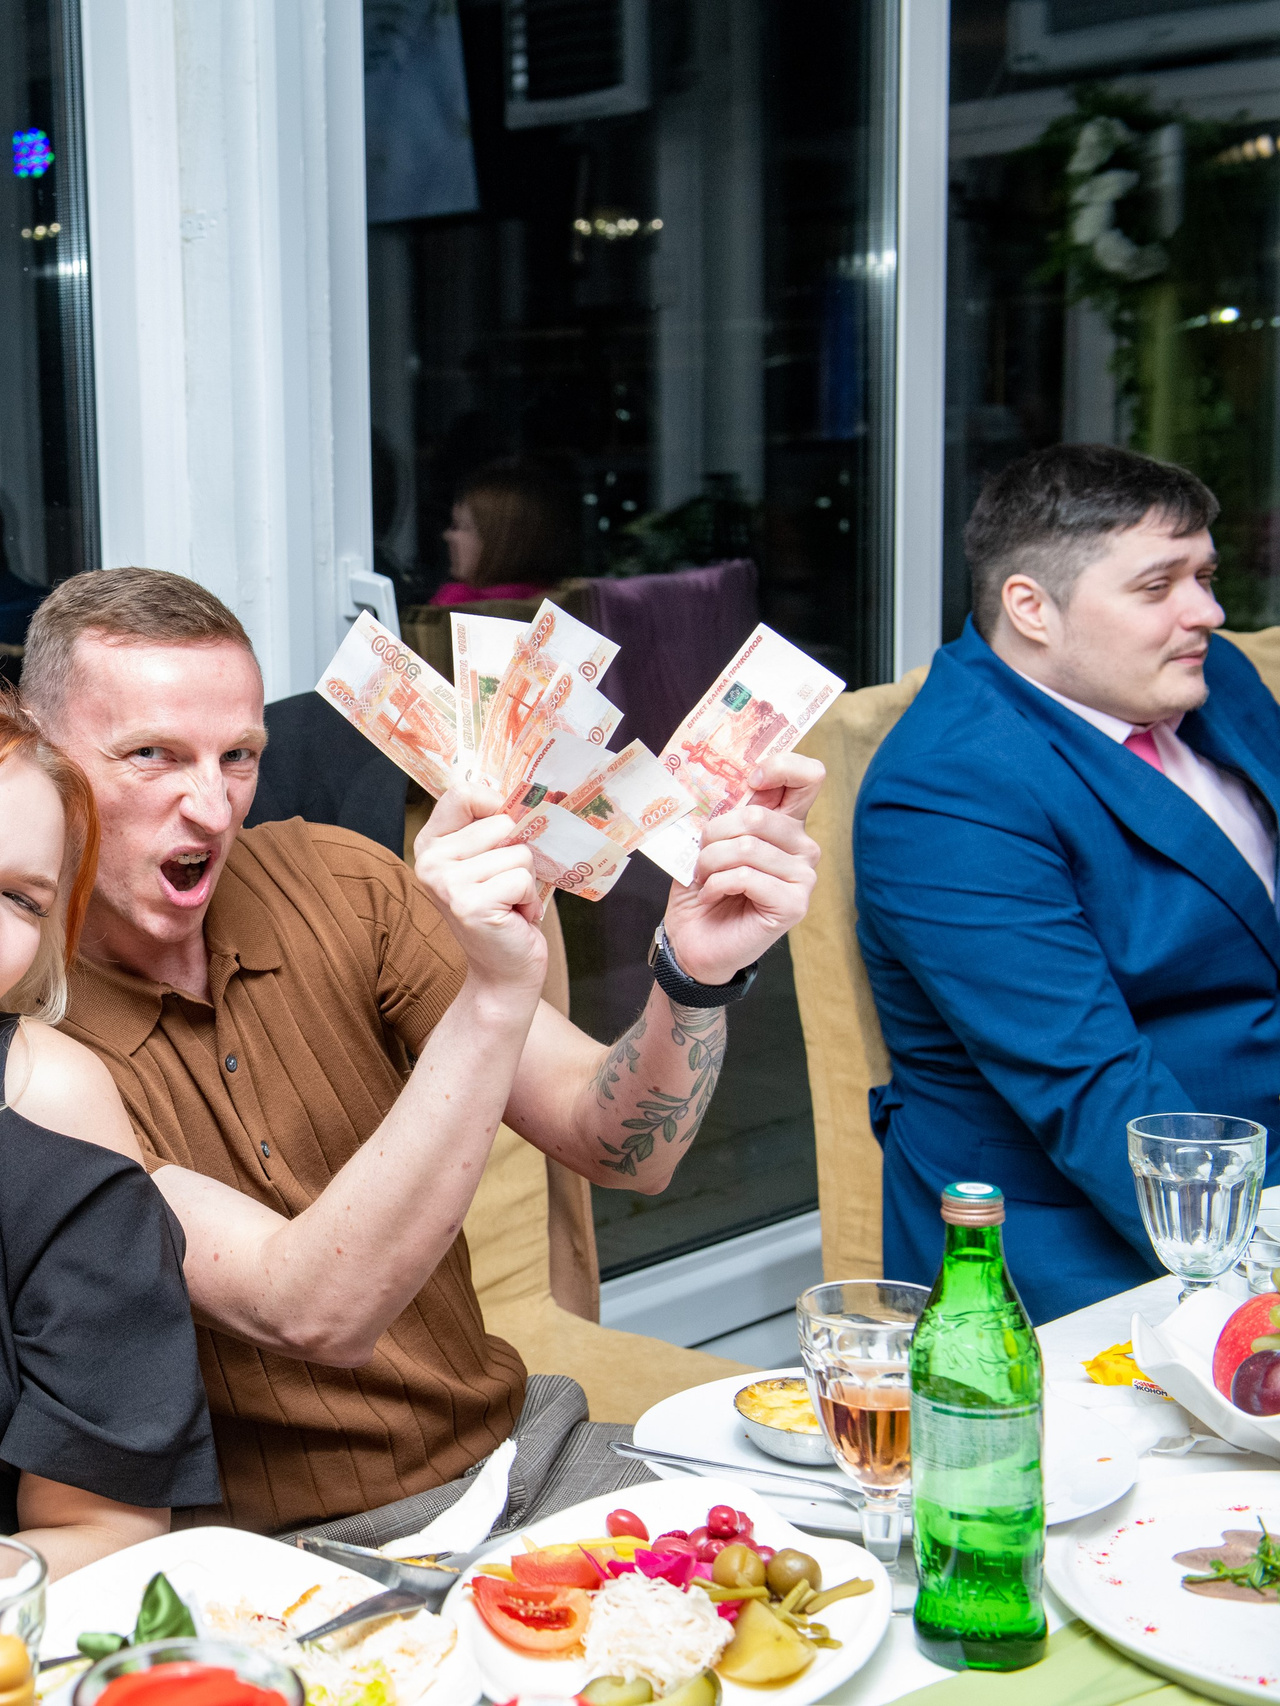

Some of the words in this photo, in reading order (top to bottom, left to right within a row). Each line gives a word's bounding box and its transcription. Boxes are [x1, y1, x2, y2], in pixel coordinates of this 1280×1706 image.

[457, 623, 466, 654] ПЯТЬ
[531, 615, 553, 648] 5000
[370, 635, 422, 682] 5000
[327, 680, 356, 708] 5000
[459, 658, 470, 699] ТЫСЯЧ
[548, 676, 571, 709] 5000
[686, 703, 708, 729] БИЛЕТ
[707, 678, 728, 704] БАНКА
[727, 634, 763, 678] ПРИКОЛОВ
[507, 783, 528, 809] БАНКА
[525, 737, 556, 782] ПРИКОЛОВ
[607, 748, 635, 772] ПЯТЬ
[518, 815, 545, 842] 5000
[643, 801, 674, 826] 5000
